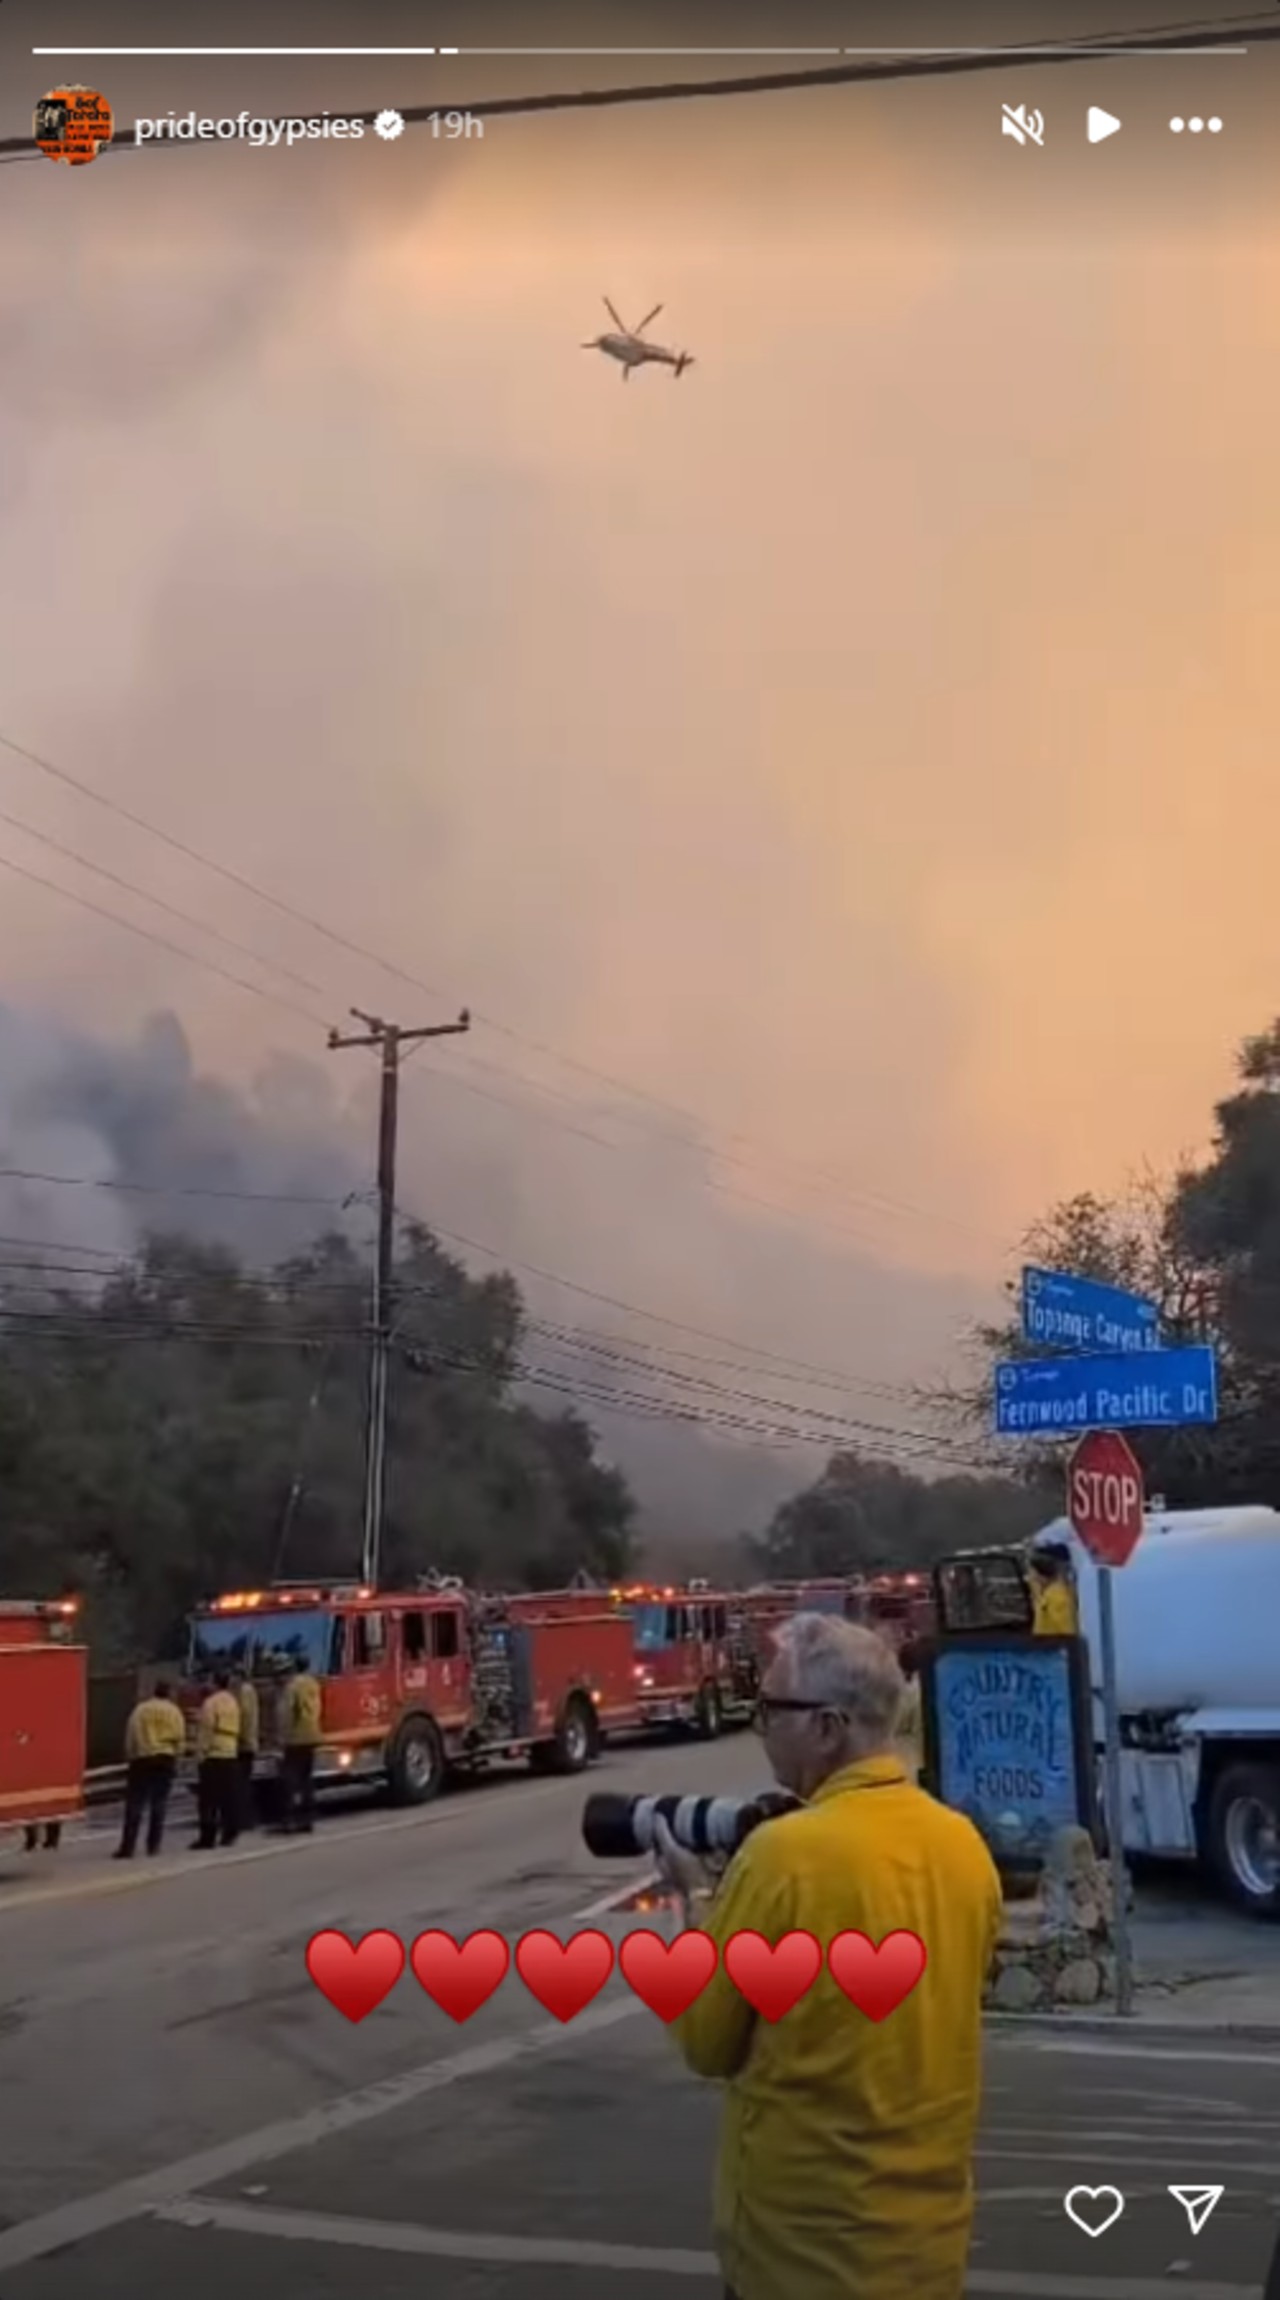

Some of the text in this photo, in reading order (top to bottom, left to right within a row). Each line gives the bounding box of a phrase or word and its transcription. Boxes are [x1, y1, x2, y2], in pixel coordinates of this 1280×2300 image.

[999, 1383, 1209, 1427] Fernwood Pacific Dr
[1073, 1468, 1138, 1525] STOP
[950, 1661, 1063, 1728] COUNTRY
[957, 1710, 1065, 1774] NATURAL
[973, 1766, 1044, 1800] FOODS
